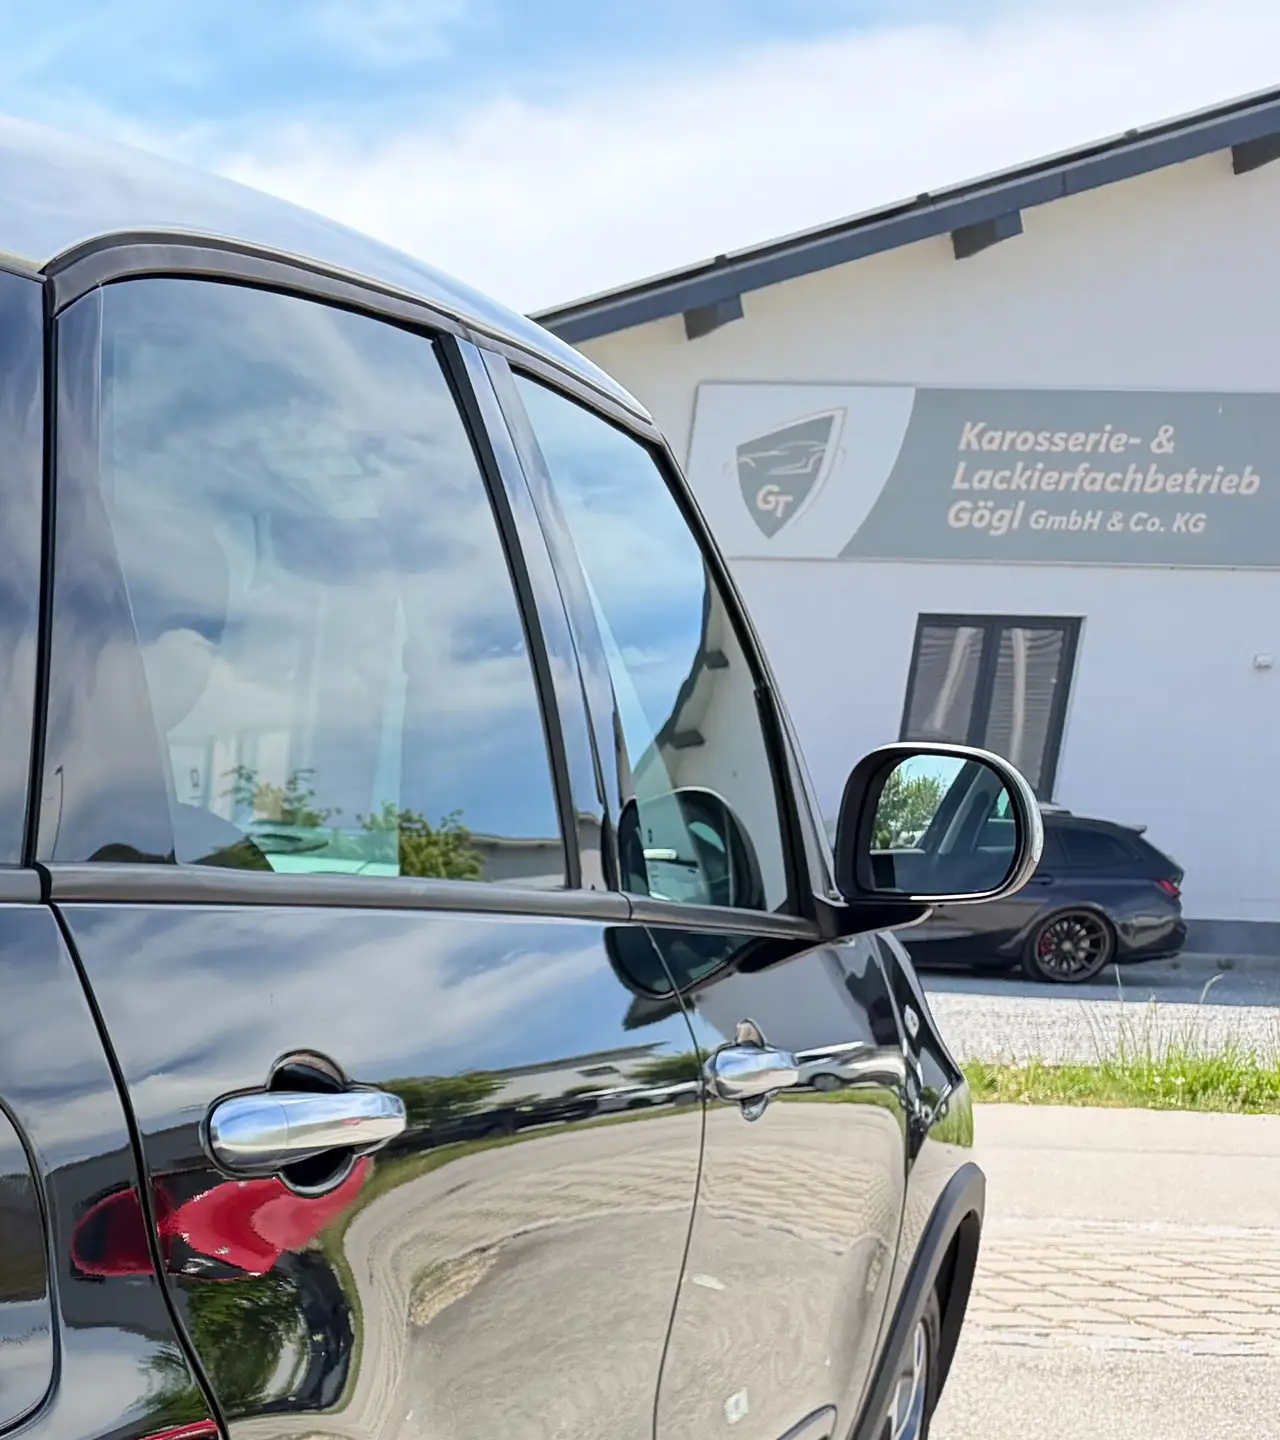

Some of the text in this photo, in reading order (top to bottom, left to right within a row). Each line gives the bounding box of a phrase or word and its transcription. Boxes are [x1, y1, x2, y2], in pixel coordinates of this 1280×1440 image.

[958, 421, 1175, 454] Karosserie- &
[952, 461, 1261, 495] Lackierfachbetrieb
[756, 484, 793, 517] GT
[948, 500, 1207, 536] Gögl GmbH & Co. KG
